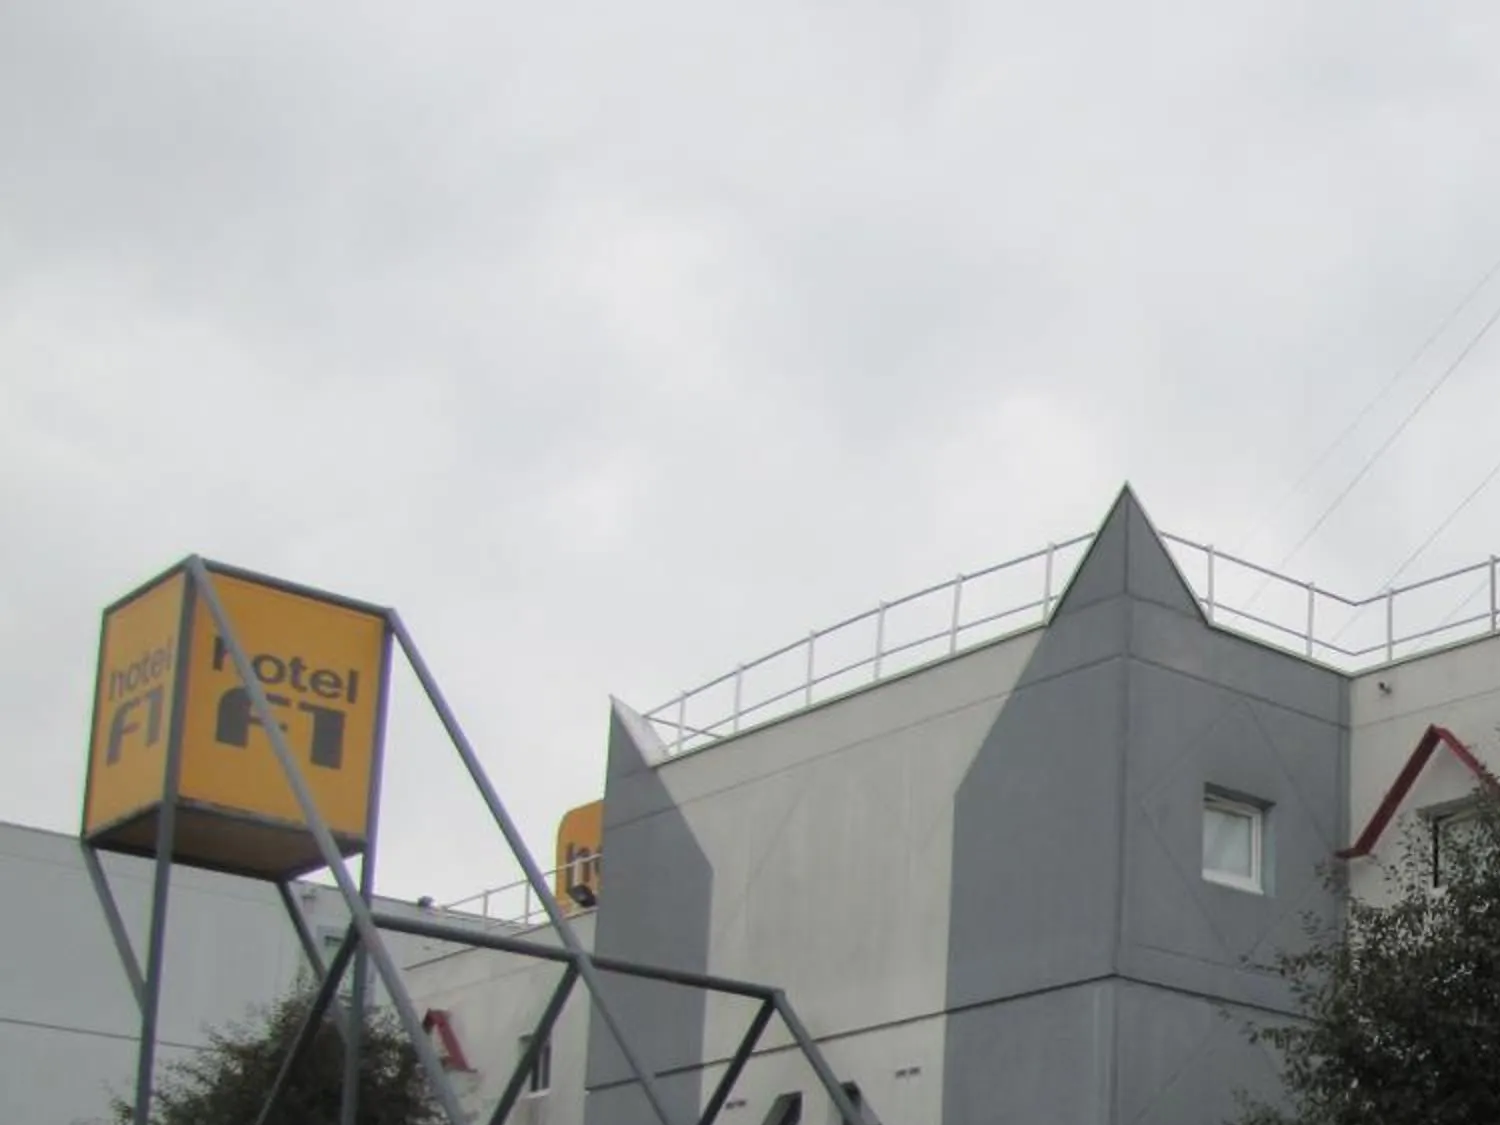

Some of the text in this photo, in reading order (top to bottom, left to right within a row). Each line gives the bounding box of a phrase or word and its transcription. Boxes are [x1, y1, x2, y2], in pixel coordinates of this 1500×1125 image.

[109, 637, 173, 701] hotel
[106, 685, 164, 767] F1
[214, 687, 346, 769] F1
